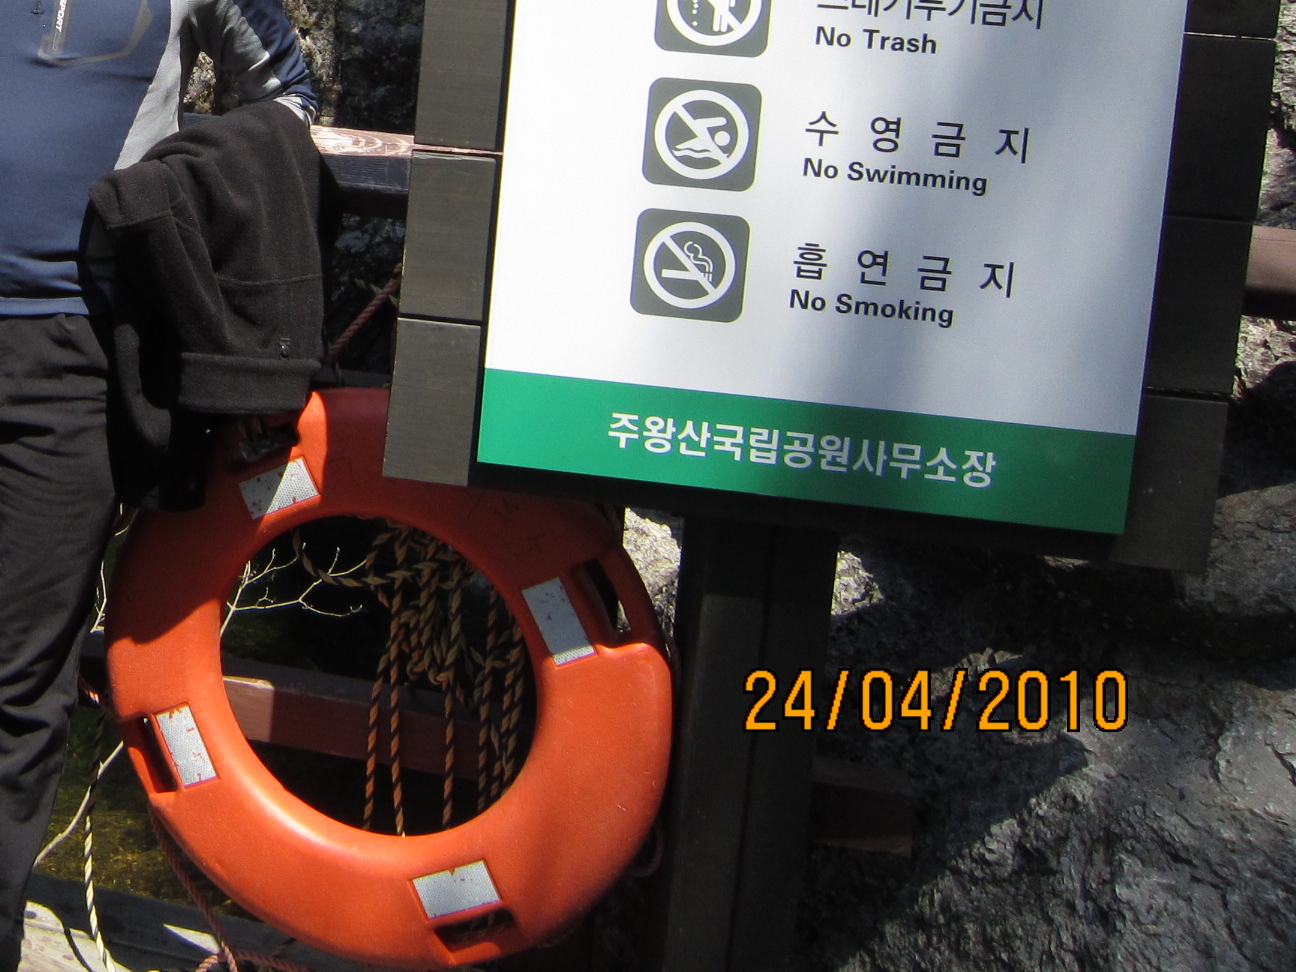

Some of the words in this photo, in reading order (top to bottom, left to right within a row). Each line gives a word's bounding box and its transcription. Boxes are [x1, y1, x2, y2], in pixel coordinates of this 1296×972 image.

[815, 26, 852, 48] No
[862, 28, 937, 54] Trash
[802, 157, 839, 179] No
[846, 161, 988, 196] Swimming
[789, 288, 826, 311] No
[835, 293, 954, 329] Smoking
[607, 412, 997, 488] 주왕산국립공원사무소장
